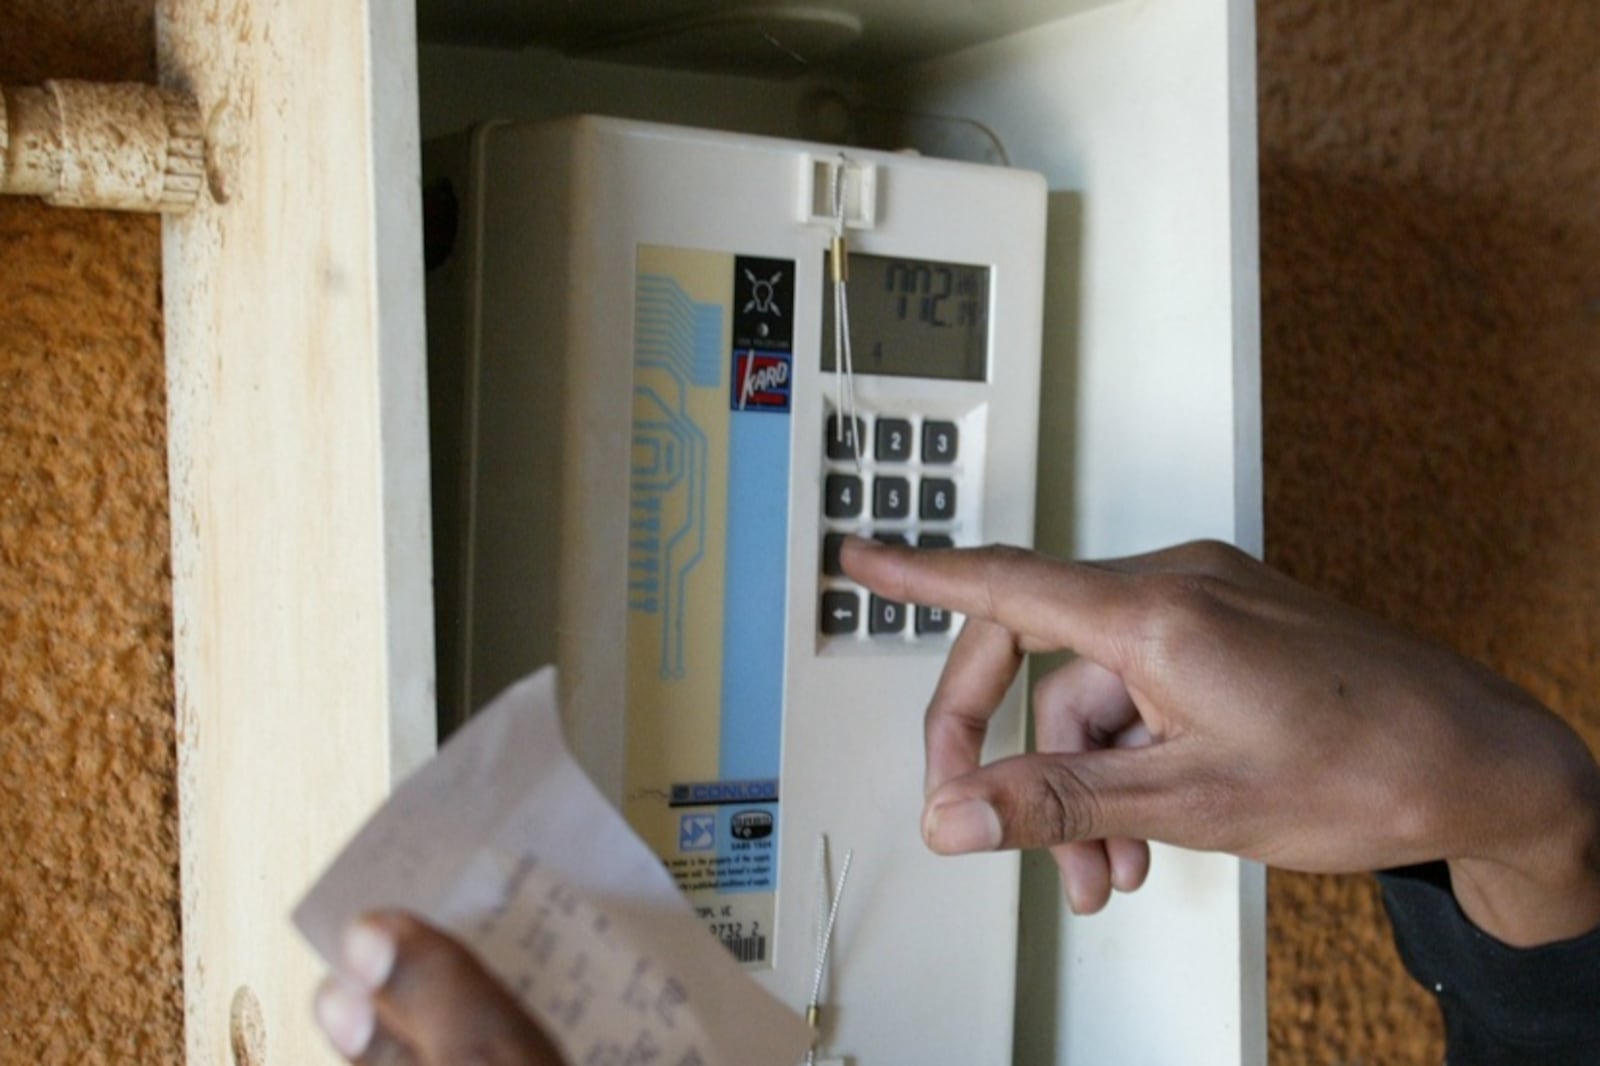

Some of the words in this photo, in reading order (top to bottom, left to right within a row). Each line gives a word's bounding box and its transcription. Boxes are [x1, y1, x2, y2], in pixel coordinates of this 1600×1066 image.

[845, 429, 852, 446] 1
[891, 432, 901, 450] 2
[937, 435, 948, 453] 3
[841, 488, 851, 504] 4
[888, 490, 898, 508] 5
[935, 491, 945, 509] 6
[884, 605, 896, 623] 0
